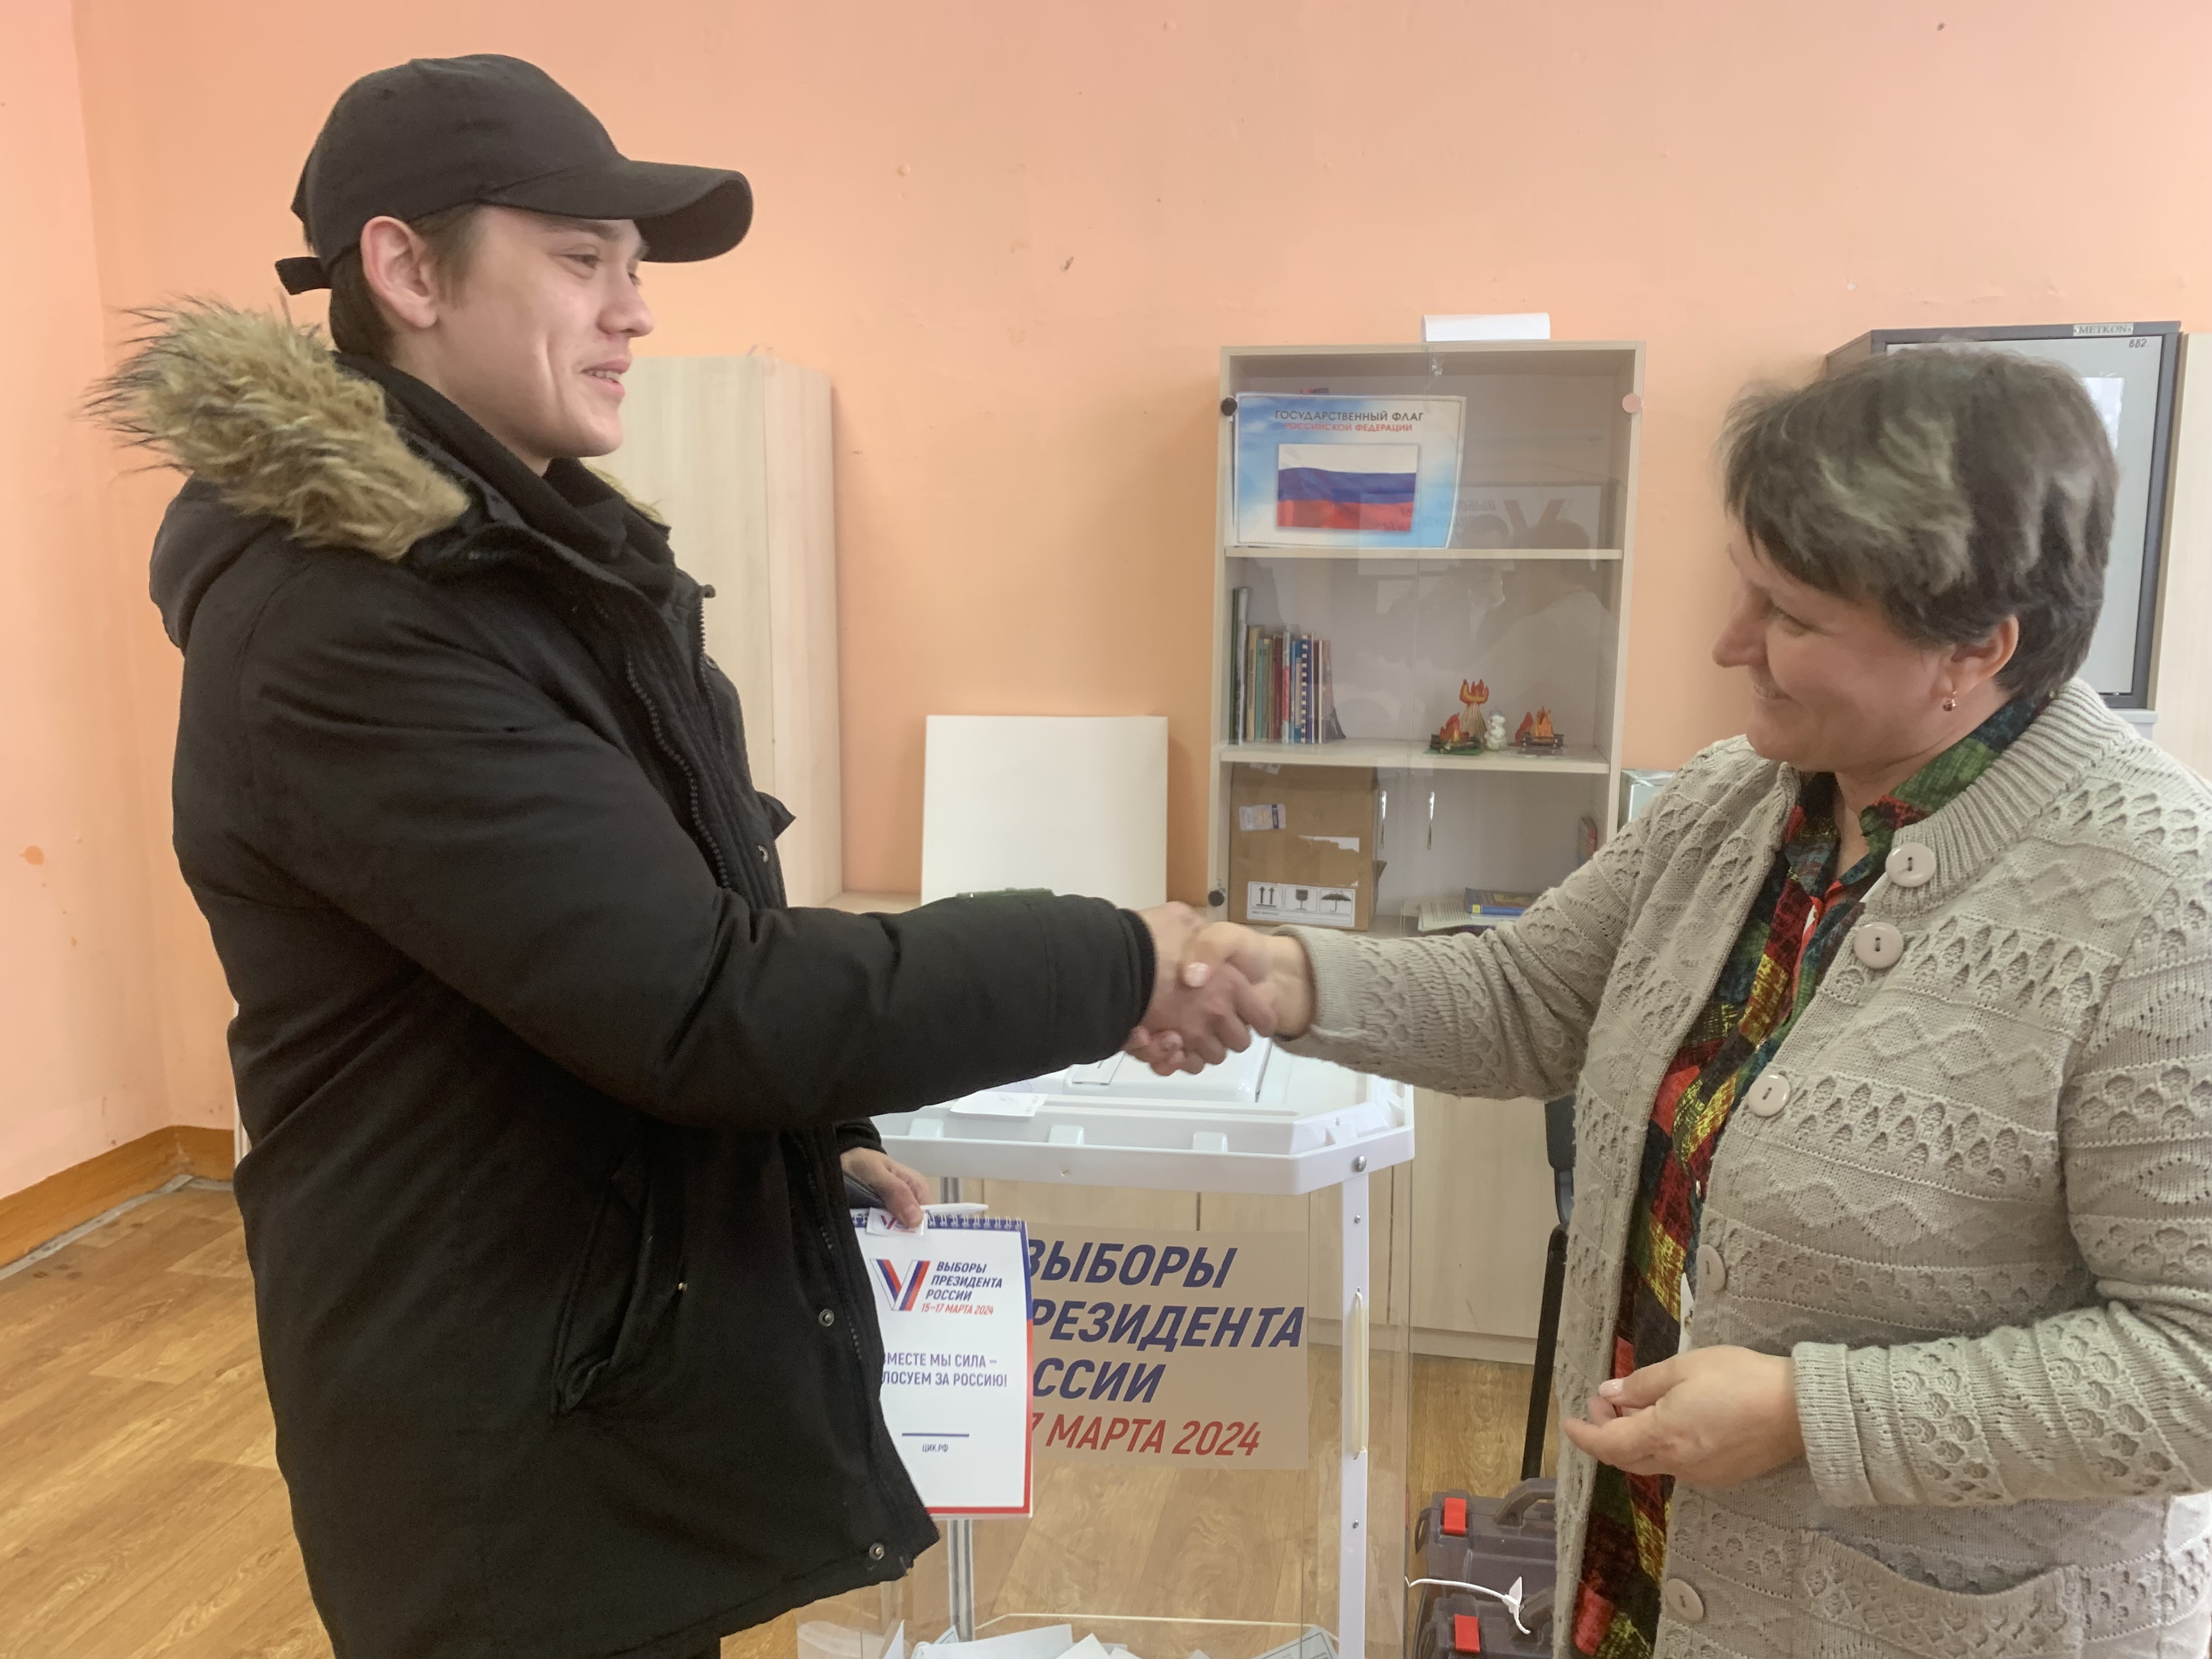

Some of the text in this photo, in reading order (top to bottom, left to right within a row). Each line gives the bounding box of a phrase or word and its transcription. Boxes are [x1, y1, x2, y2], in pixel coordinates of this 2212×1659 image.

[2079, 325, 2128, 334] METKON
[1275, 410, 1424, 421] ГОСУДАРСТВЕННЫЙ ФЛАГ
[1284, 422, 1413, 432] РОССИЙСКОЙ ФЕДЕРАЦИИ
[936, 1261, 987, 1273] ВЫБОРЫ
[931, 1275, 1003, 1288] ПРЕЗИДЕНТА
[925, 1289, 972, 1301] РОССИИ
[945, 1304, 973, 1314] МАРТА
[974, 1305, 994, 1315] 2024
[1032, 1299, 1305, 1352] РЕЗИДЕНТА
[884, 1352, 926, 1366] МЕСТЕ
[930, 1353, 951, 1367] МЫ
[955, 1354, 986, 1368] СИЛА
[882, 1371, 1007, 1387] ЛОСУЕМ ЗА РОССИЮ!
[1032, 1357, 1166, 1403] ССИИ
[1045, 1413, 1166, 1454] МАРТА
[1171, 1420, 1261, 1456] 2024
[922, 1443, 949, 1453] ЦИК.РФ
